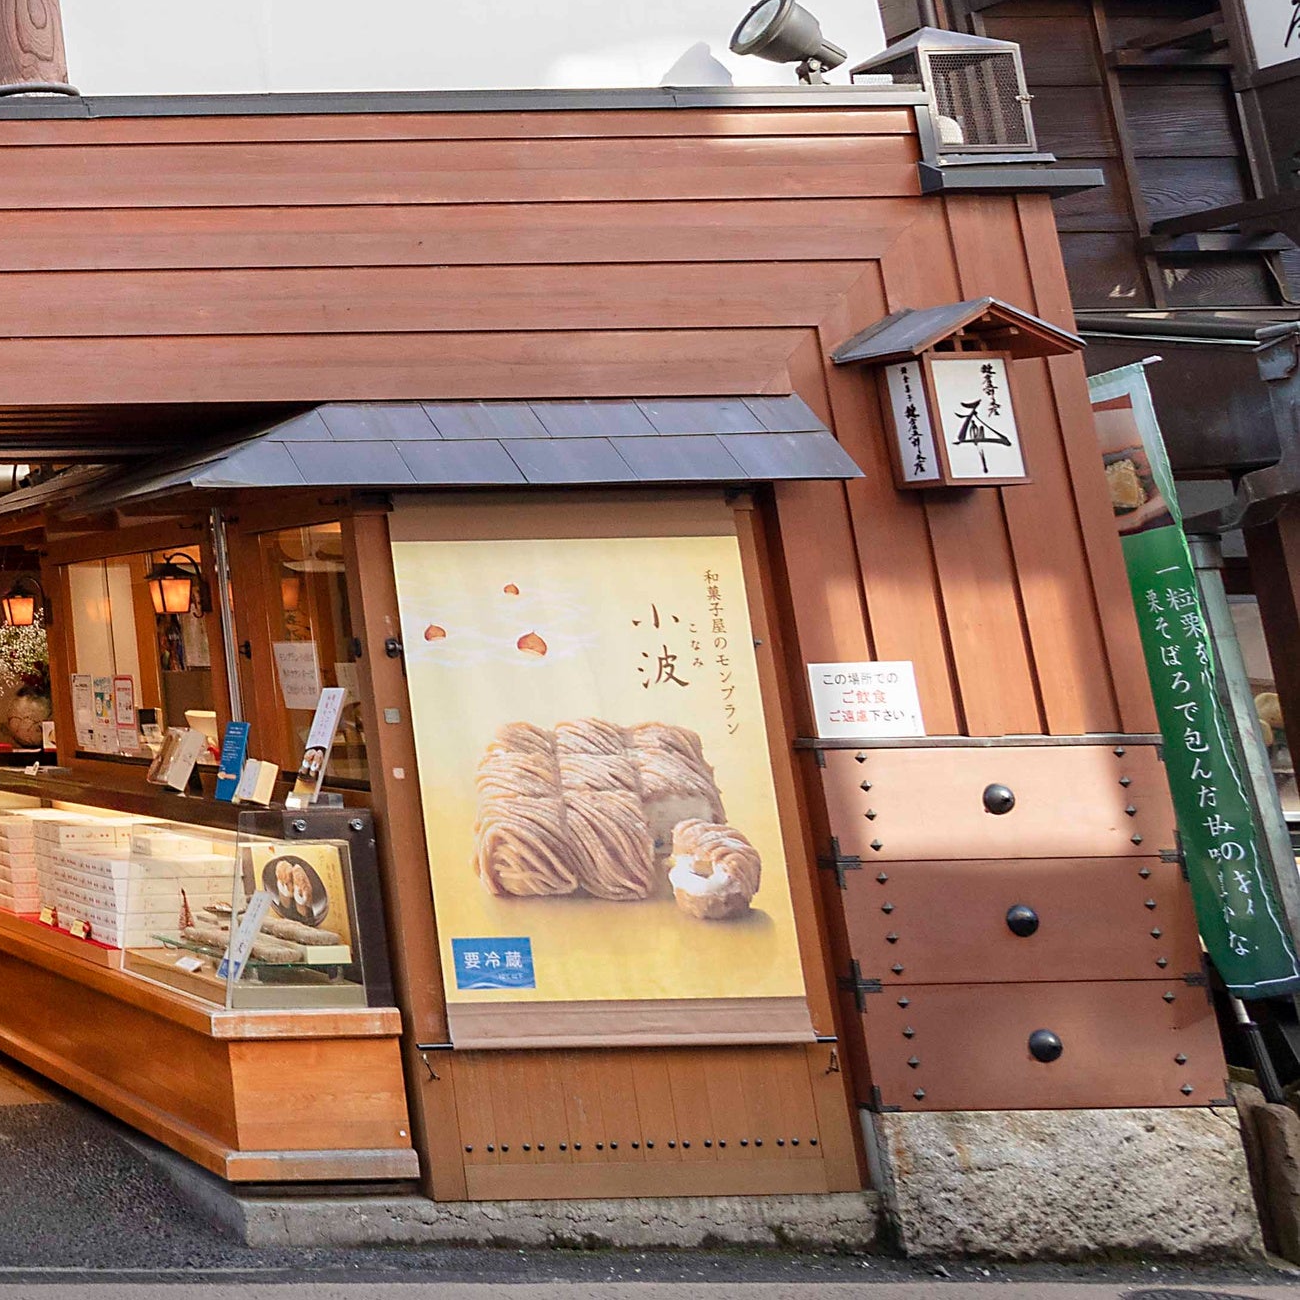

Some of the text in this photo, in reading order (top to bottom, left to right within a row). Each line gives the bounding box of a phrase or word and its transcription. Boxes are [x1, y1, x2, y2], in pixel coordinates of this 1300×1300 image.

[632, 603, 689, 689] 小波
[688, 623, 704, 667] こなみ
[704, 569, 740, 736] 和菓子屋のモンブラン
[823, 672, 899, 685] この場所での
[842, 690, 887, 704] ご飲食
[830, 709, 905, 722] ご遠慮下さい
[463, 950, 523, 969] 要冷蔵
